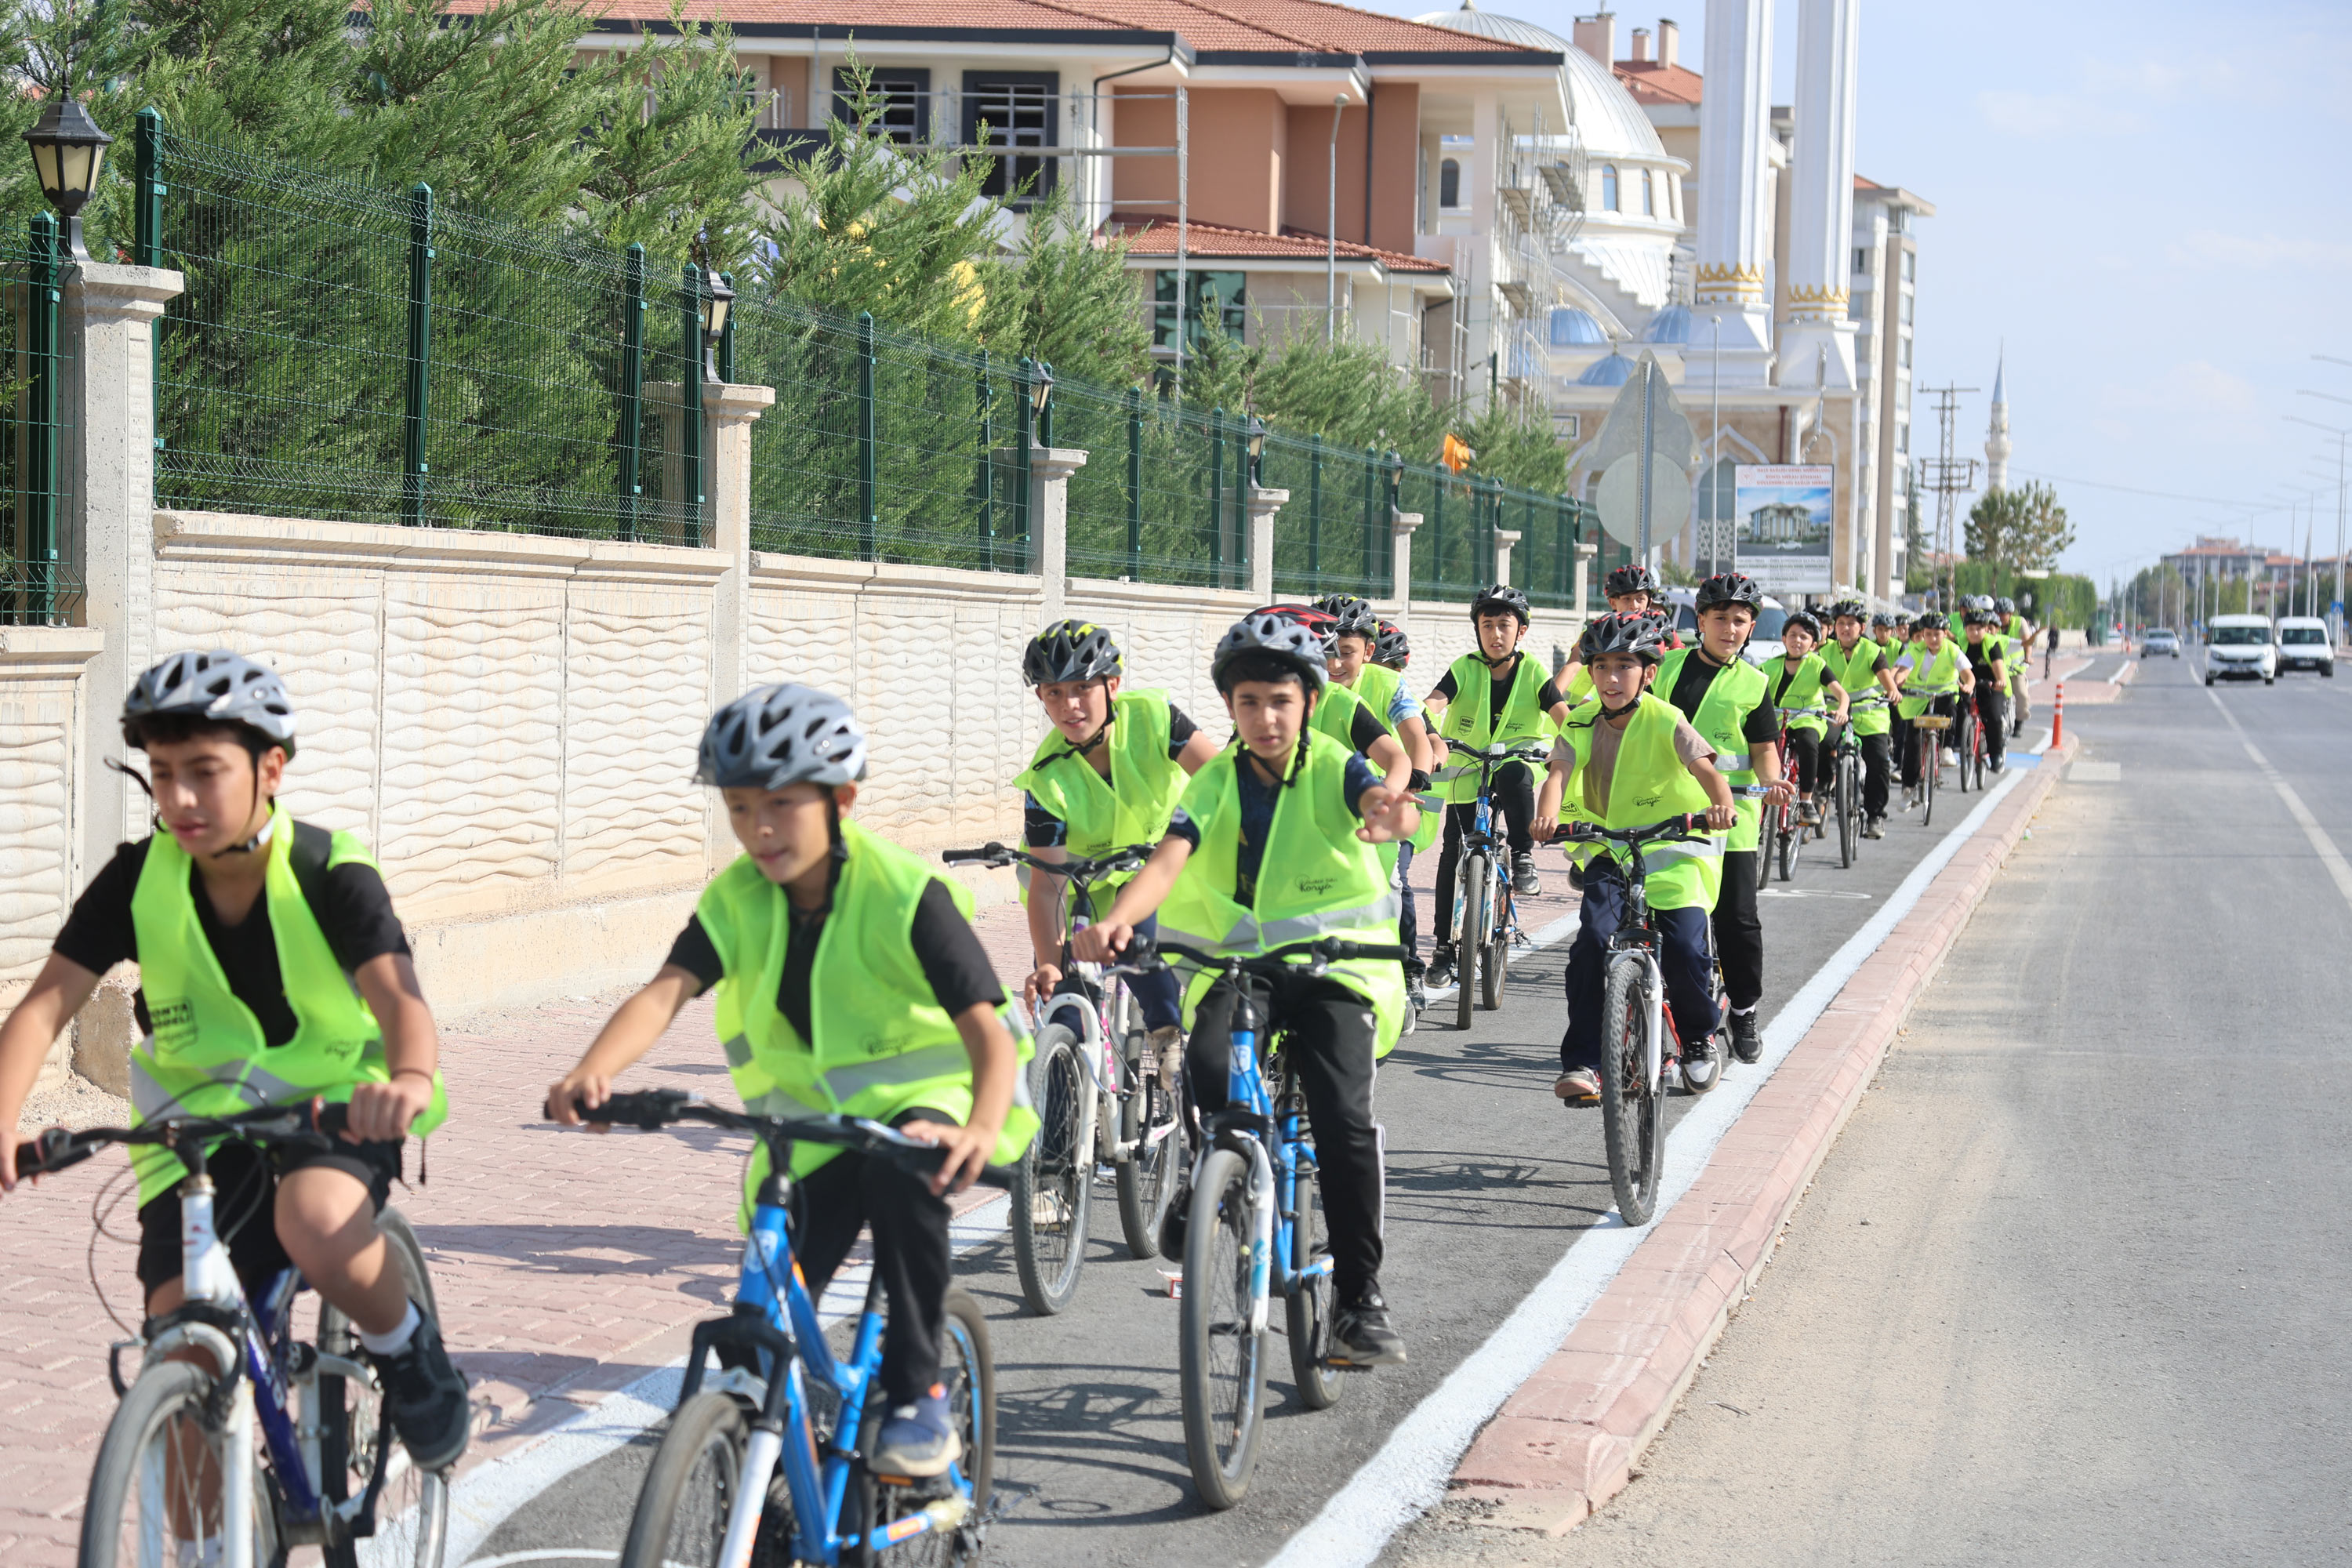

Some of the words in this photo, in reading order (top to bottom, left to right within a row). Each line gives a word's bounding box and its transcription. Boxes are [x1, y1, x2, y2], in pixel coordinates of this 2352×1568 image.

[1636, 798, 1661, 808] Konya
[1300, 884, 1331, 895] Konya
[150, 1004, 189, 1019] ONYA
